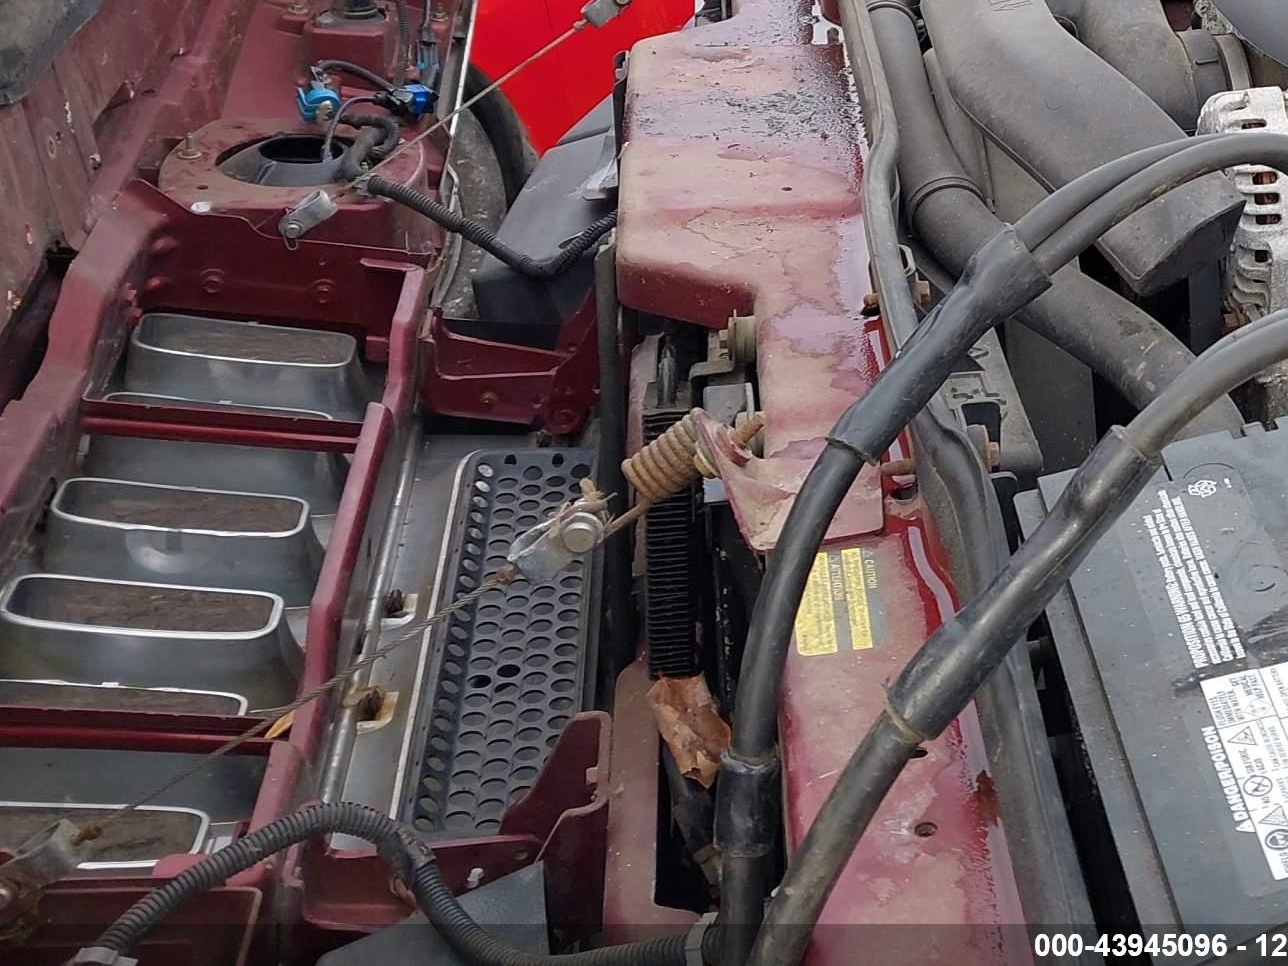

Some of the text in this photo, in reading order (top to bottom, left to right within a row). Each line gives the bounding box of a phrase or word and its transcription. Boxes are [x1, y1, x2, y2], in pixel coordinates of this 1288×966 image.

[830, 563, 843, 601] ATTENTION
[865, 559, 878, 589] CAUTION
[1200, 722, 1249, 823] DANGER/POISON
